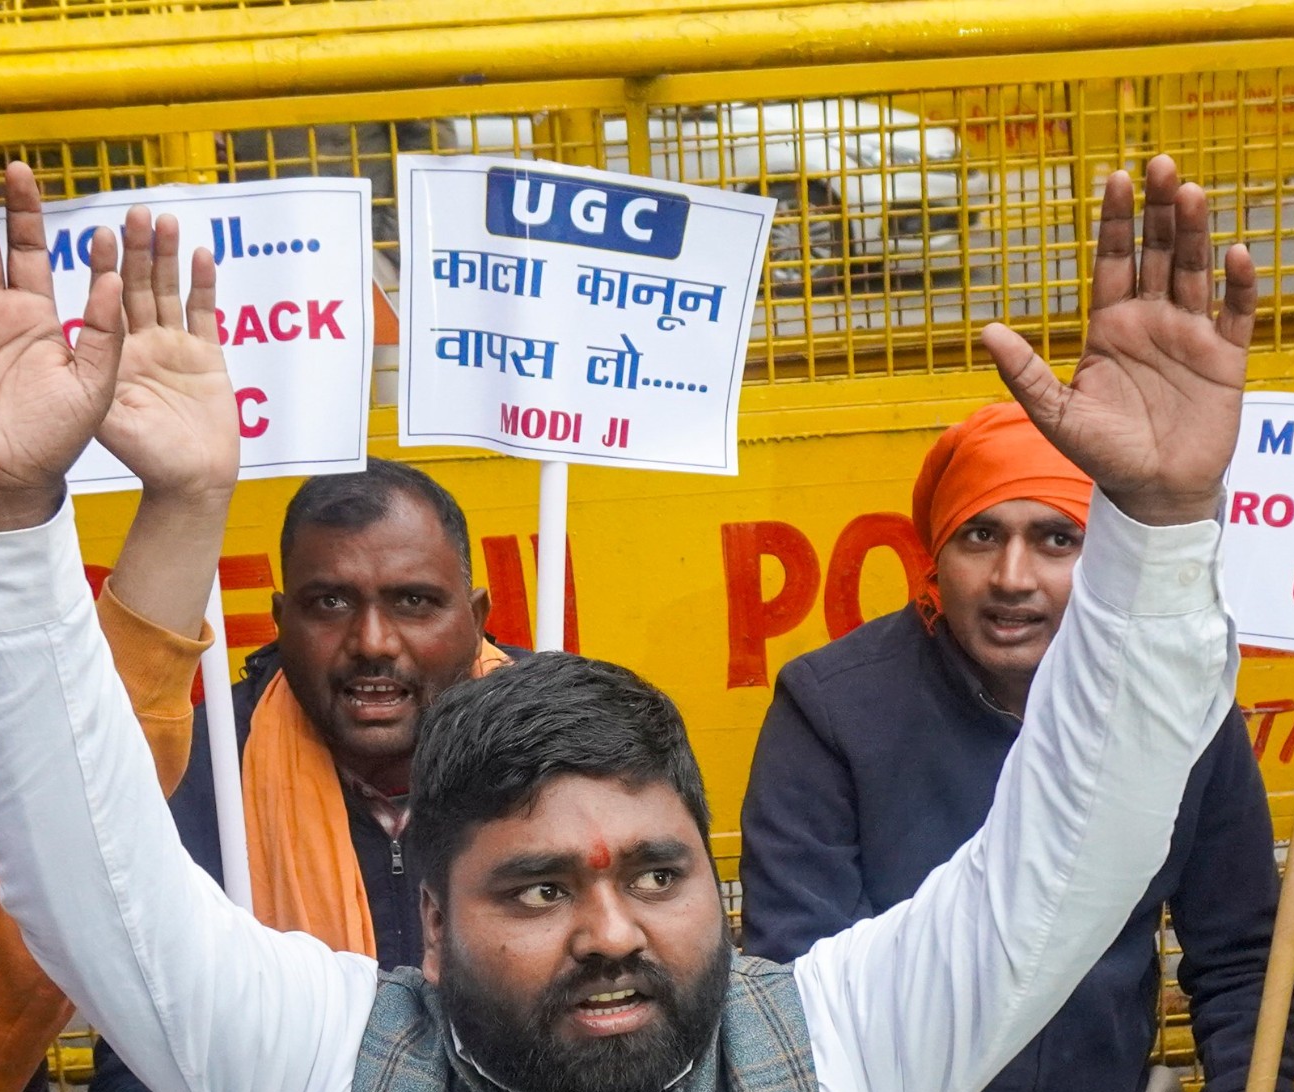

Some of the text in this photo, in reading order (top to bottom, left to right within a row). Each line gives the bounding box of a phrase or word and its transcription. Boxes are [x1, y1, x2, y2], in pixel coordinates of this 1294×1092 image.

[433, 249, 727, 331] काला कानून
[431, 328, 559, 379] वापस
[501, 403, 629, 448] MODI JI
